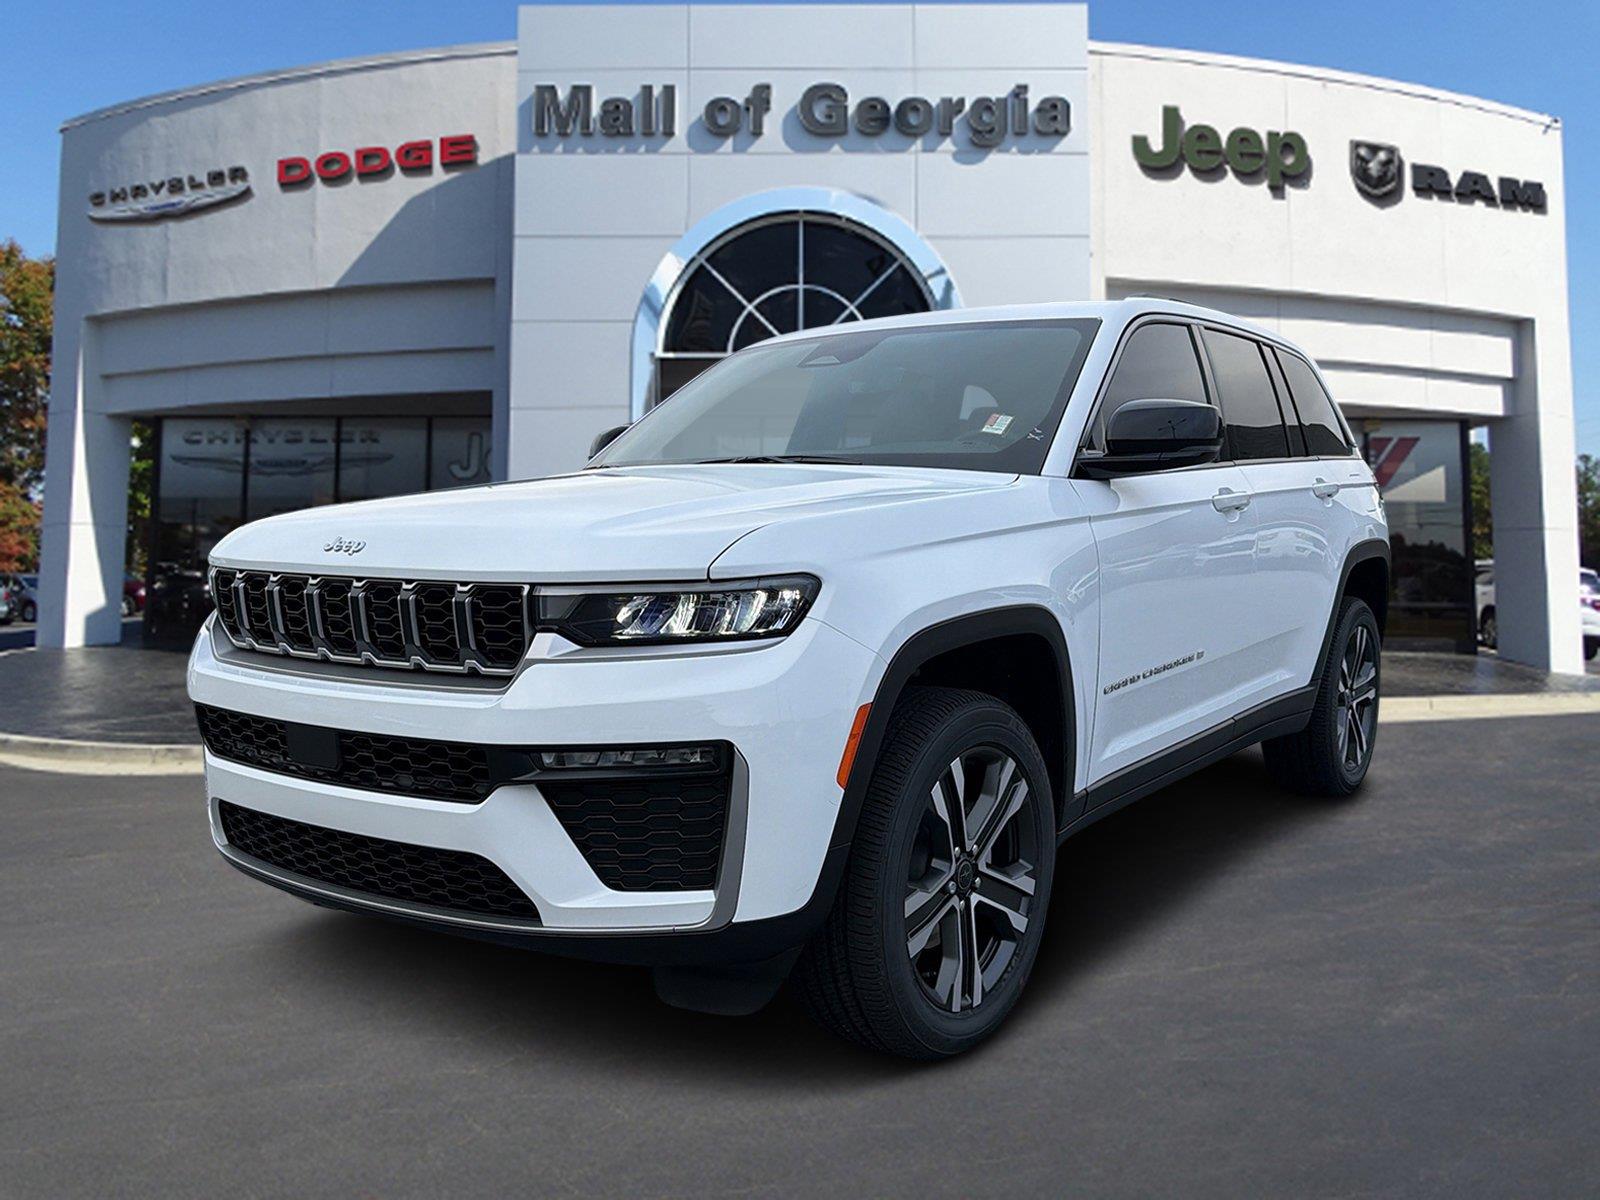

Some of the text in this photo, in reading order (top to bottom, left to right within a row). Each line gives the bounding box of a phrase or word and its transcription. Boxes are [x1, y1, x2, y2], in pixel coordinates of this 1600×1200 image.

[532, 82, 1073, 148] Mall of Georgia
[277, 134, 477, 188] DODGE
[1131, 104, 1311, 194] Jeep
[89, 166, 249, 206] CHRYSLER
[1411, 162, 1548, 214] RAM
[448, 431, 493, 481] J
[322, 535, 367, 557] Jeep
